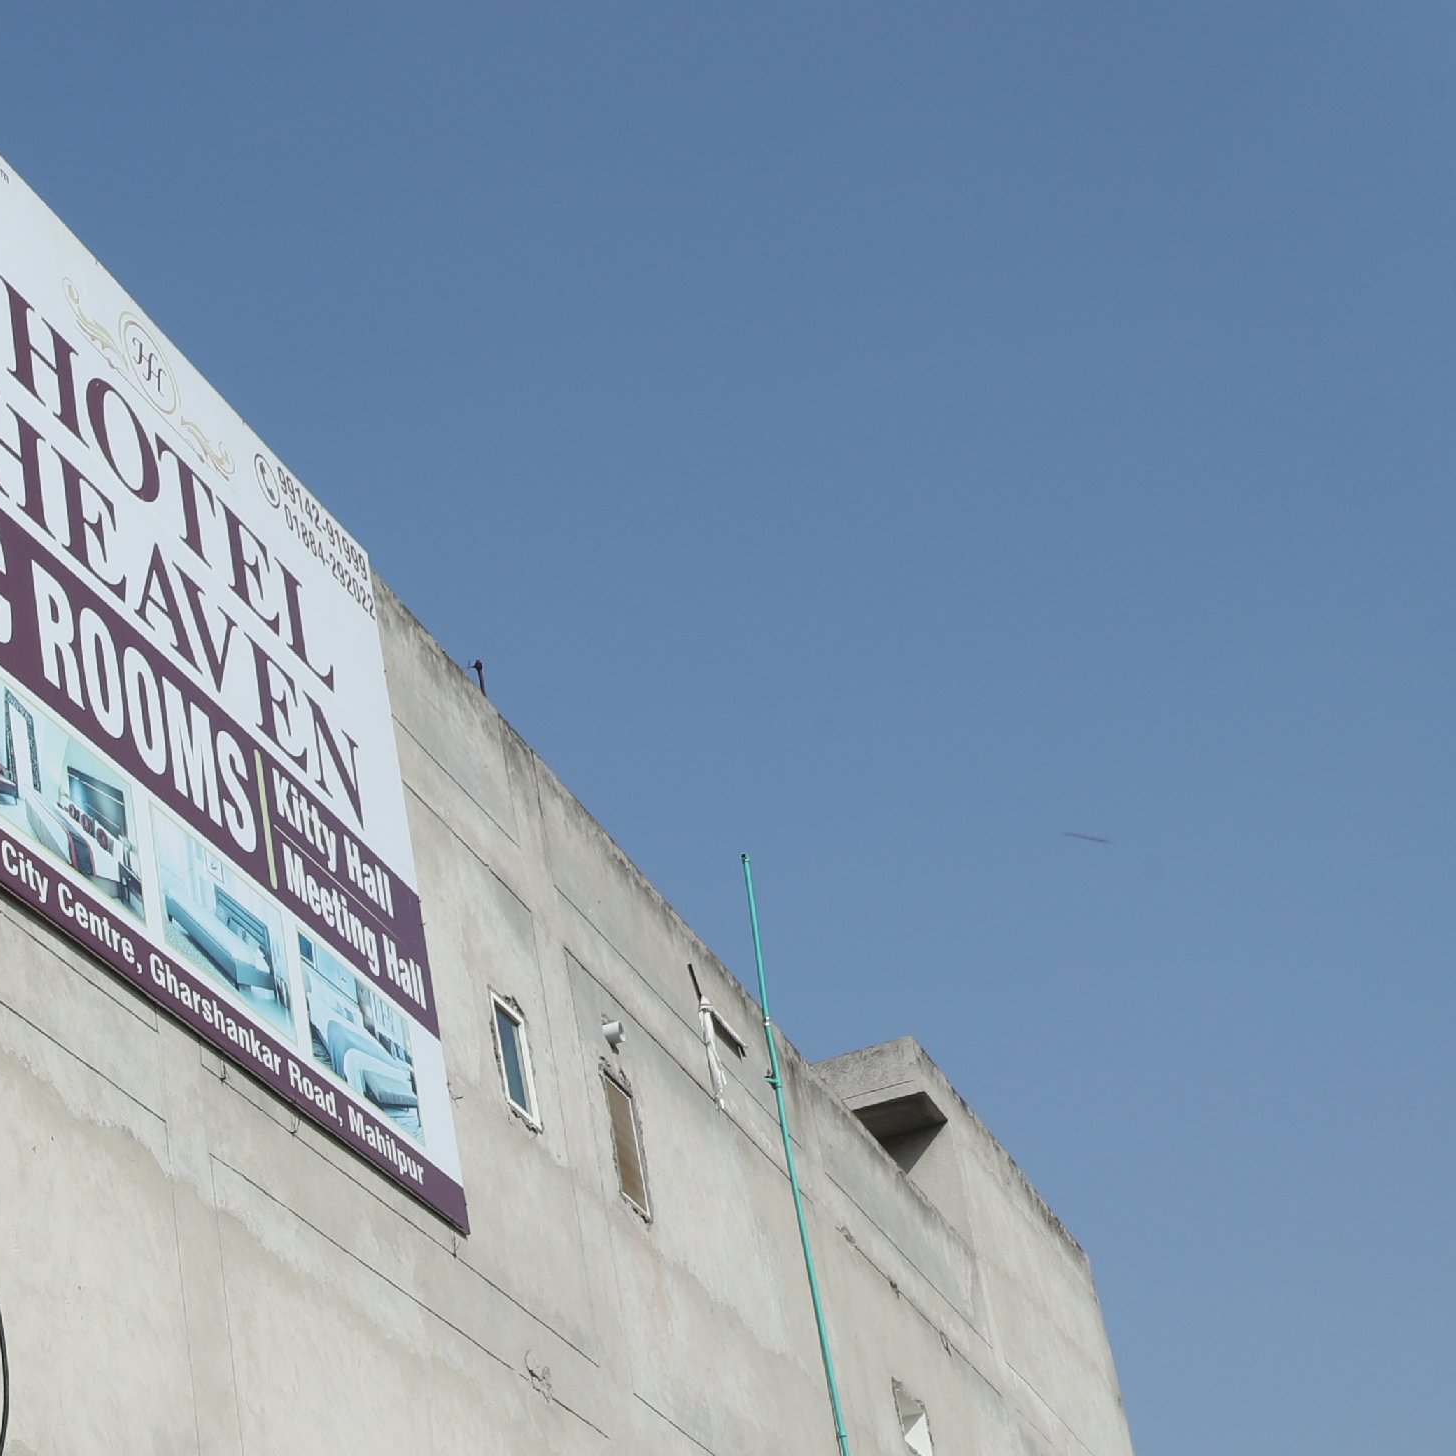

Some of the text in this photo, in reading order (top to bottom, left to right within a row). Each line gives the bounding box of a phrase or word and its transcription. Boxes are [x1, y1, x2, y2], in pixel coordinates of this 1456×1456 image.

[277, 466, 368, 582] 99142-91999
[284, 504, 376, 621] 01884-292022
[33, 568, 260, 856] ROOMS
[271, 767, 395, 920] Kitty Hall
[282, 842, 427, 1012] Meeting Hall
[1, 839, 425, 1186] City Centre, Gharshankar Road, Mahilpur
